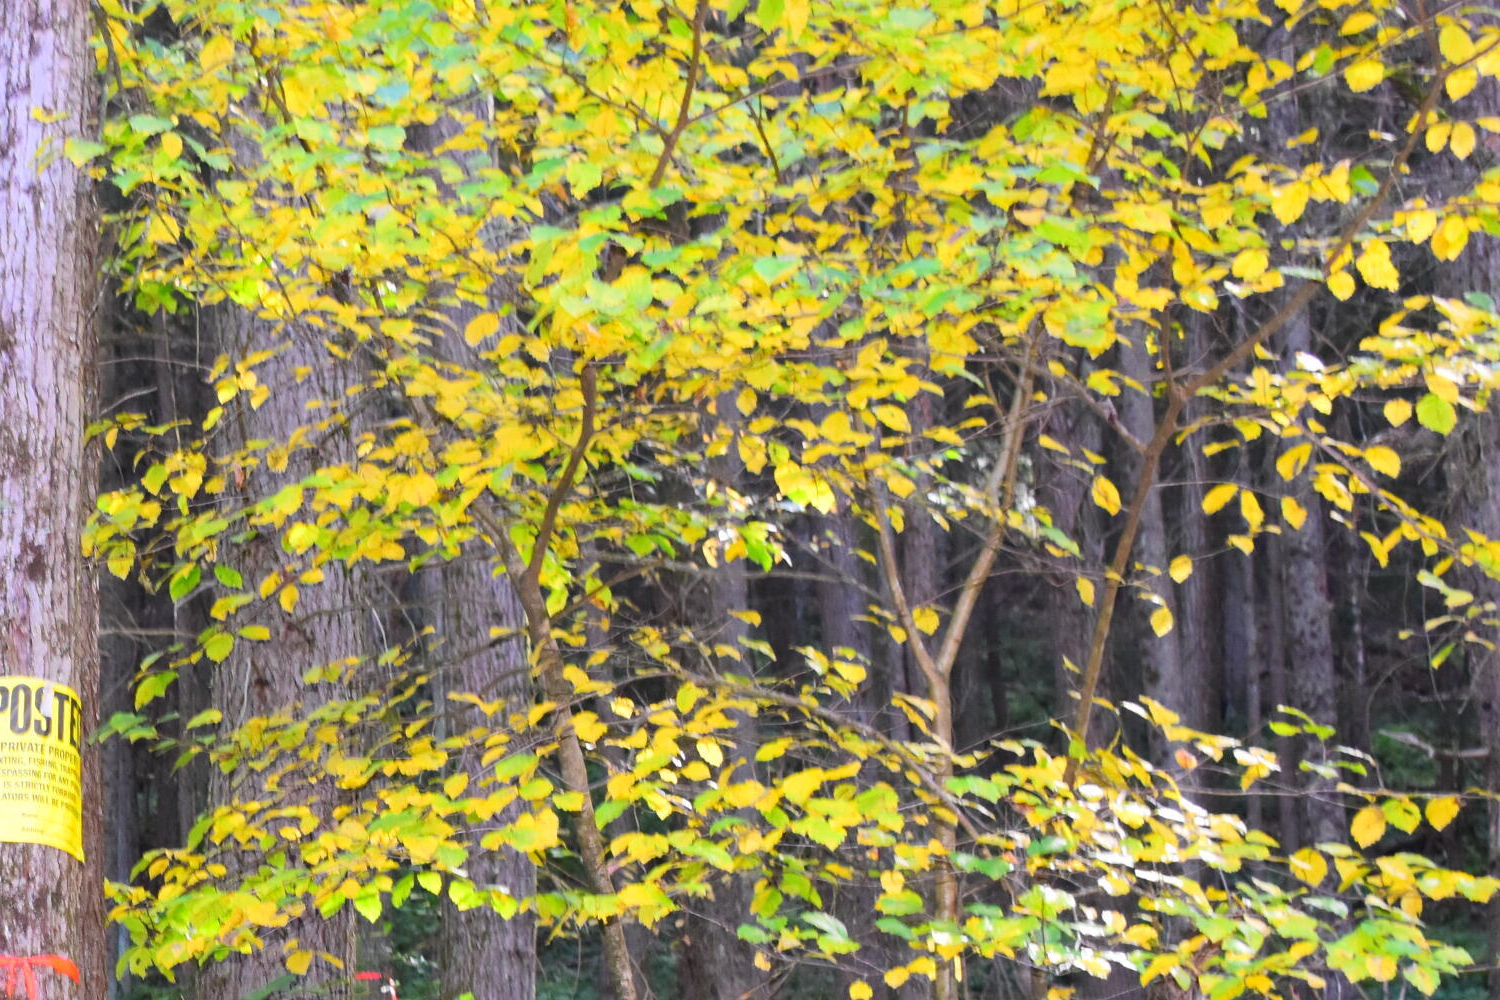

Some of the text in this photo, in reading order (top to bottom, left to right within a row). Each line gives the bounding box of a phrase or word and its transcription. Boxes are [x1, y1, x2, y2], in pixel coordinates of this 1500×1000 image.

[0, 741, 79, 766] PRIVATE PROPER
[3, 780, 11, 789] IS
[15, 780, 50, 792] STRICTLY
[43, 771, 57, 782] FOR
[58, 775, 69, 786] ANY
[32, 793, 49, 805] WILL
[51, 797, 59, 808] BE
